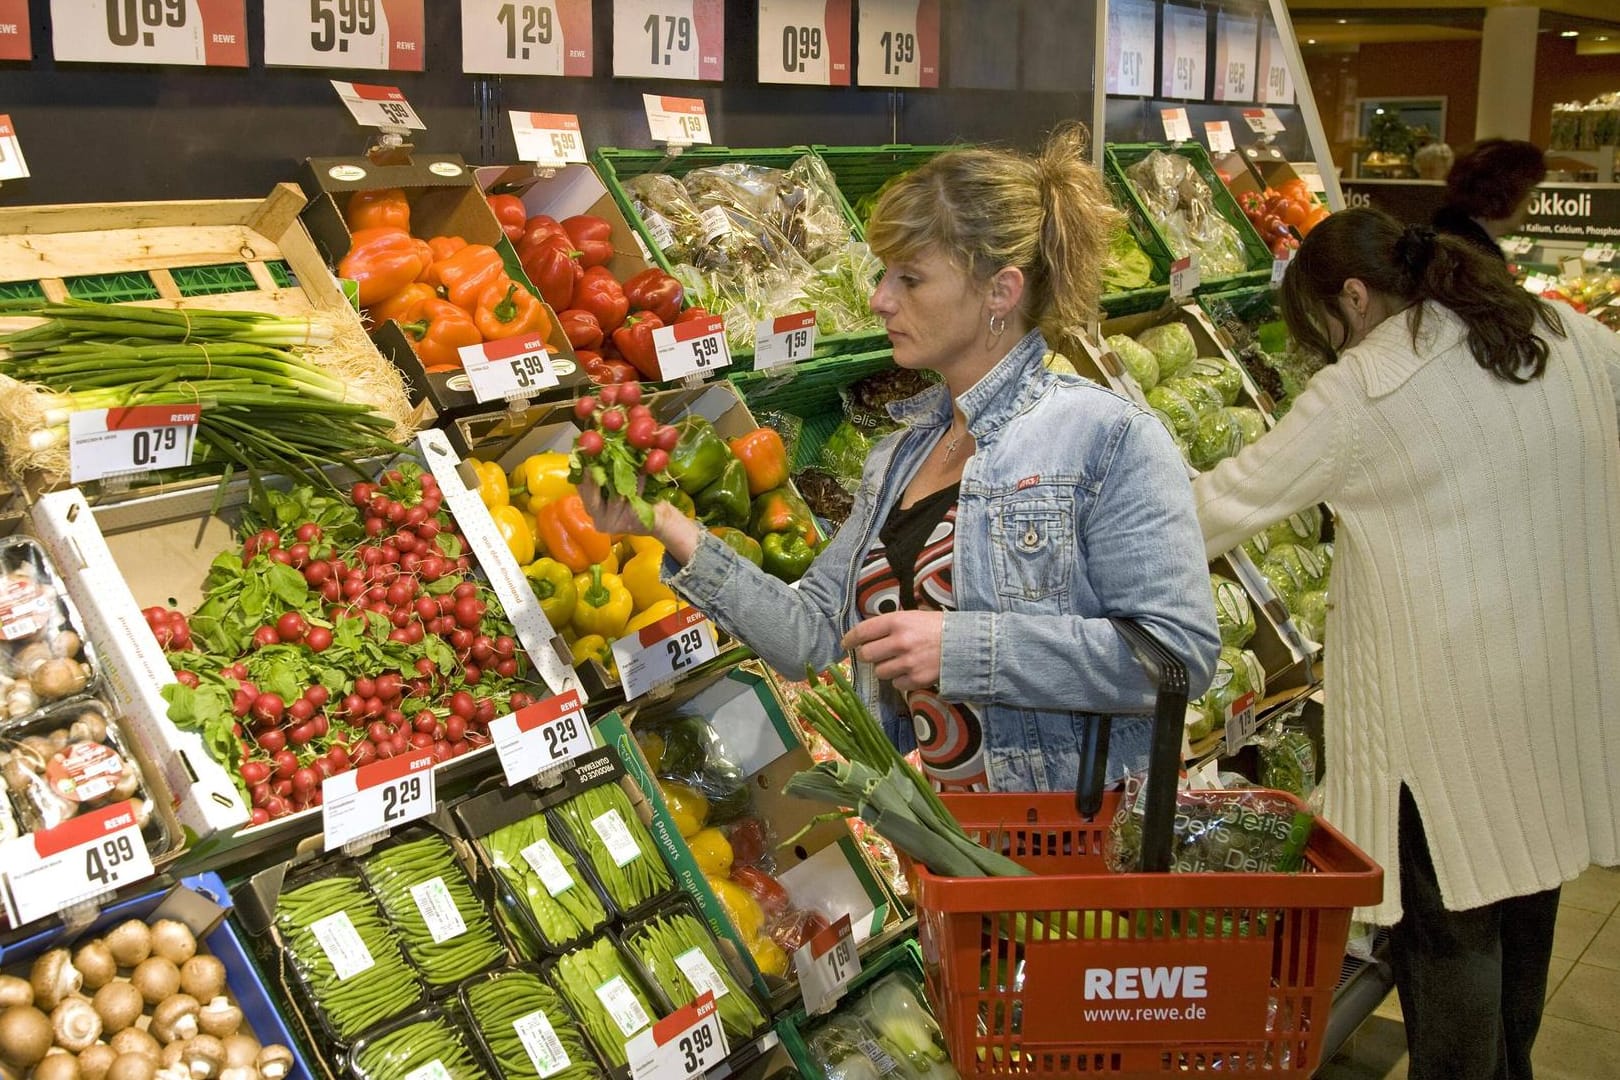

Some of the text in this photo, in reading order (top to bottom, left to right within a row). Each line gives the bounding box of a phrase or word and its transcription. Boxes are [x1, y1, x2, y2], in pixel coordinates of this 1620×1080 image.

[106, 0, 187, 47] 0.69
[212, 33, 236, 44] REWE
[310, 0, 376, 52] 5.99
[497, 5, 552, 60] 1.29
[396, 41, 416, 51] REWE
[569, 49, 586, 58] REWE
[643, 14, 691, 66] 1.79
[782, 25, 821, 73] 0.99
[880, 31, 914, 76] 1.39
[379, 103, 410, 125] 5.99
[678, 115, 702, 139] 1.59
[550, 133, 575, 158] 5.99
[708, 322, 724, 332] REWE
[524, 341, 541, 350] REWE
[691, 336, 719, 367] 5.99
[785, 330, 807, 359] 1.59
[510, 355, 544, 387] 5.99
[170, 413, 196, 422] REWE
[133, 427, 176, 466] 0.79
[666, 628, 703, 671] 2.29
[560, 699, 579, 712] REWE
[543, 718, 578, 760] 2.29
[410, 757, 432, 771] REWE
[574, 756, 609, 774] GUATEMALA
[578, 763, 614, 783] PRODUCE OF
[382, 776, 421, 823] 2.29
[104, 810, 132, 831] REWE
[85, 834, 135, 886] 4.99
[656, 820, 681, 861] Peppers
[682, 870, 707, 909] Paprika
[827, 941, 850, 983] 1.69
[1084, 966, 1208, 1000] REWE
[697, 1002, 714, 1017] REWE
[1084, 1004, 1206, 1021] www.rewe.de
[679, 1023, 713, 1075] 3.99
